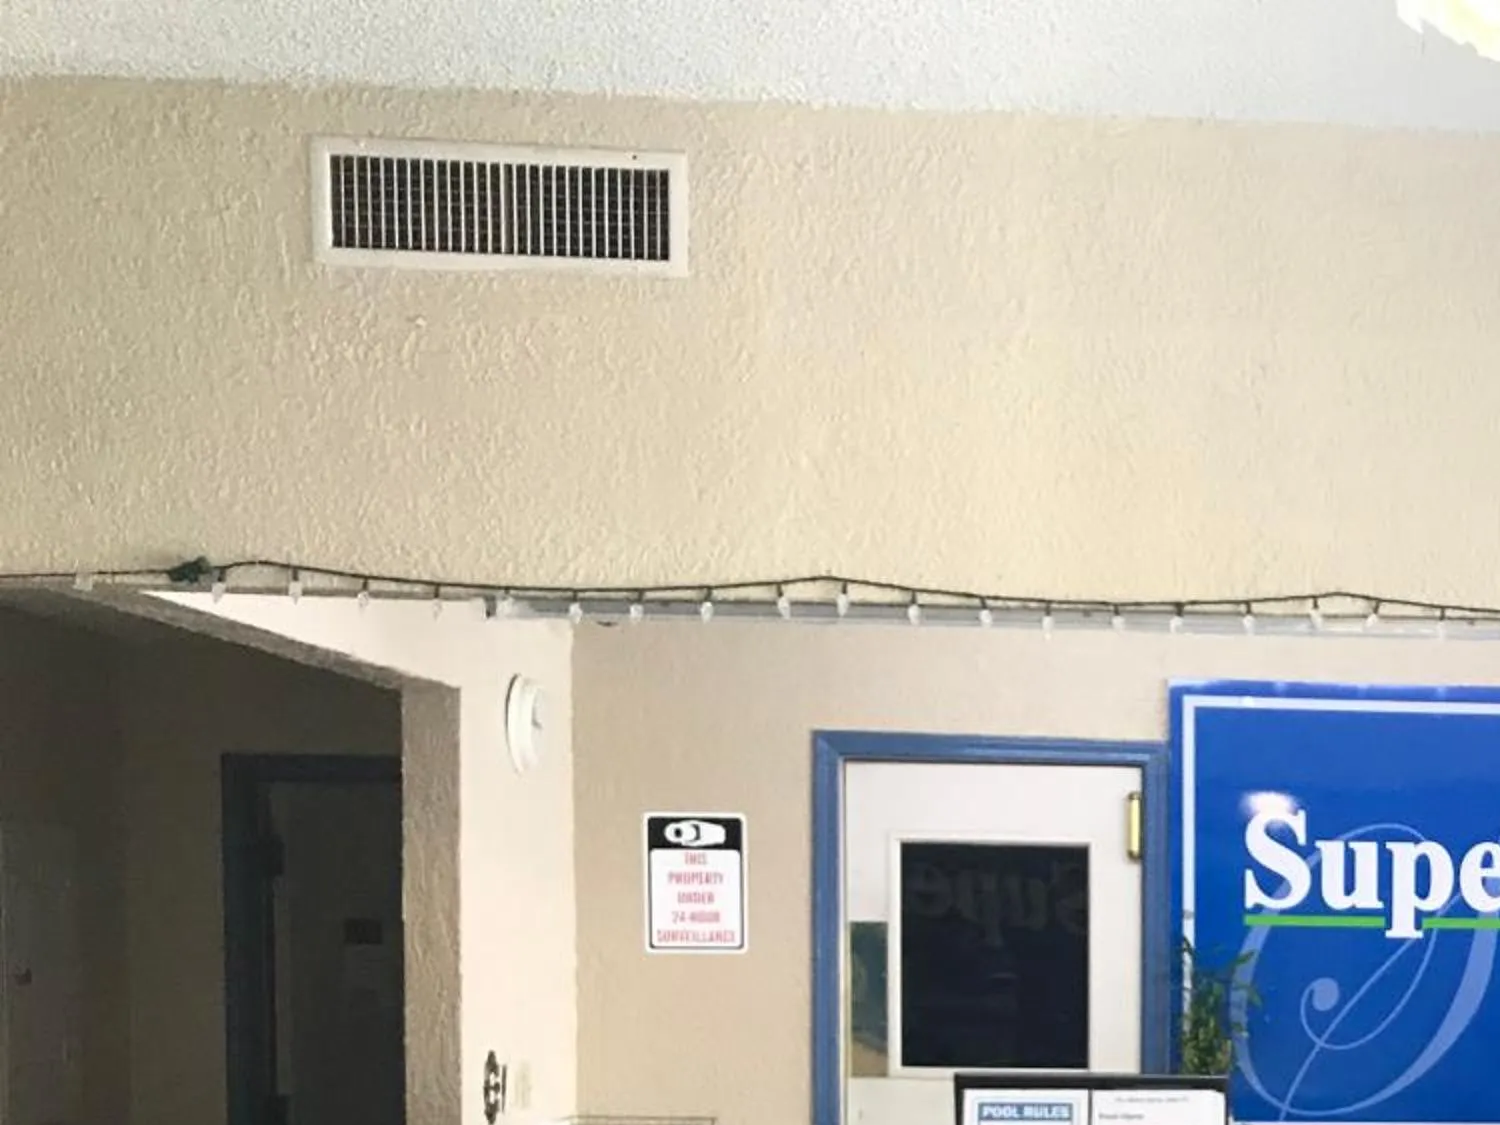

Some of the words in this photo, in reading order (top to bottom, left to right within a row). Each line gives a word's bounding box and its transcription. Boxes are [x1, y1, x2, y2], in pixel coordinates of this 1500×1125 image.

[684, 851, 708, 866] THIS
[667, 871, 724, 885] PROPERTY
[677, 891, 715, 905] UNDER
[656, 928, 736, 944] SURVEILLANCE
[982, 1104, 1019, 1119] POOL
[1022, 1103, 1070, 1119] RULES
